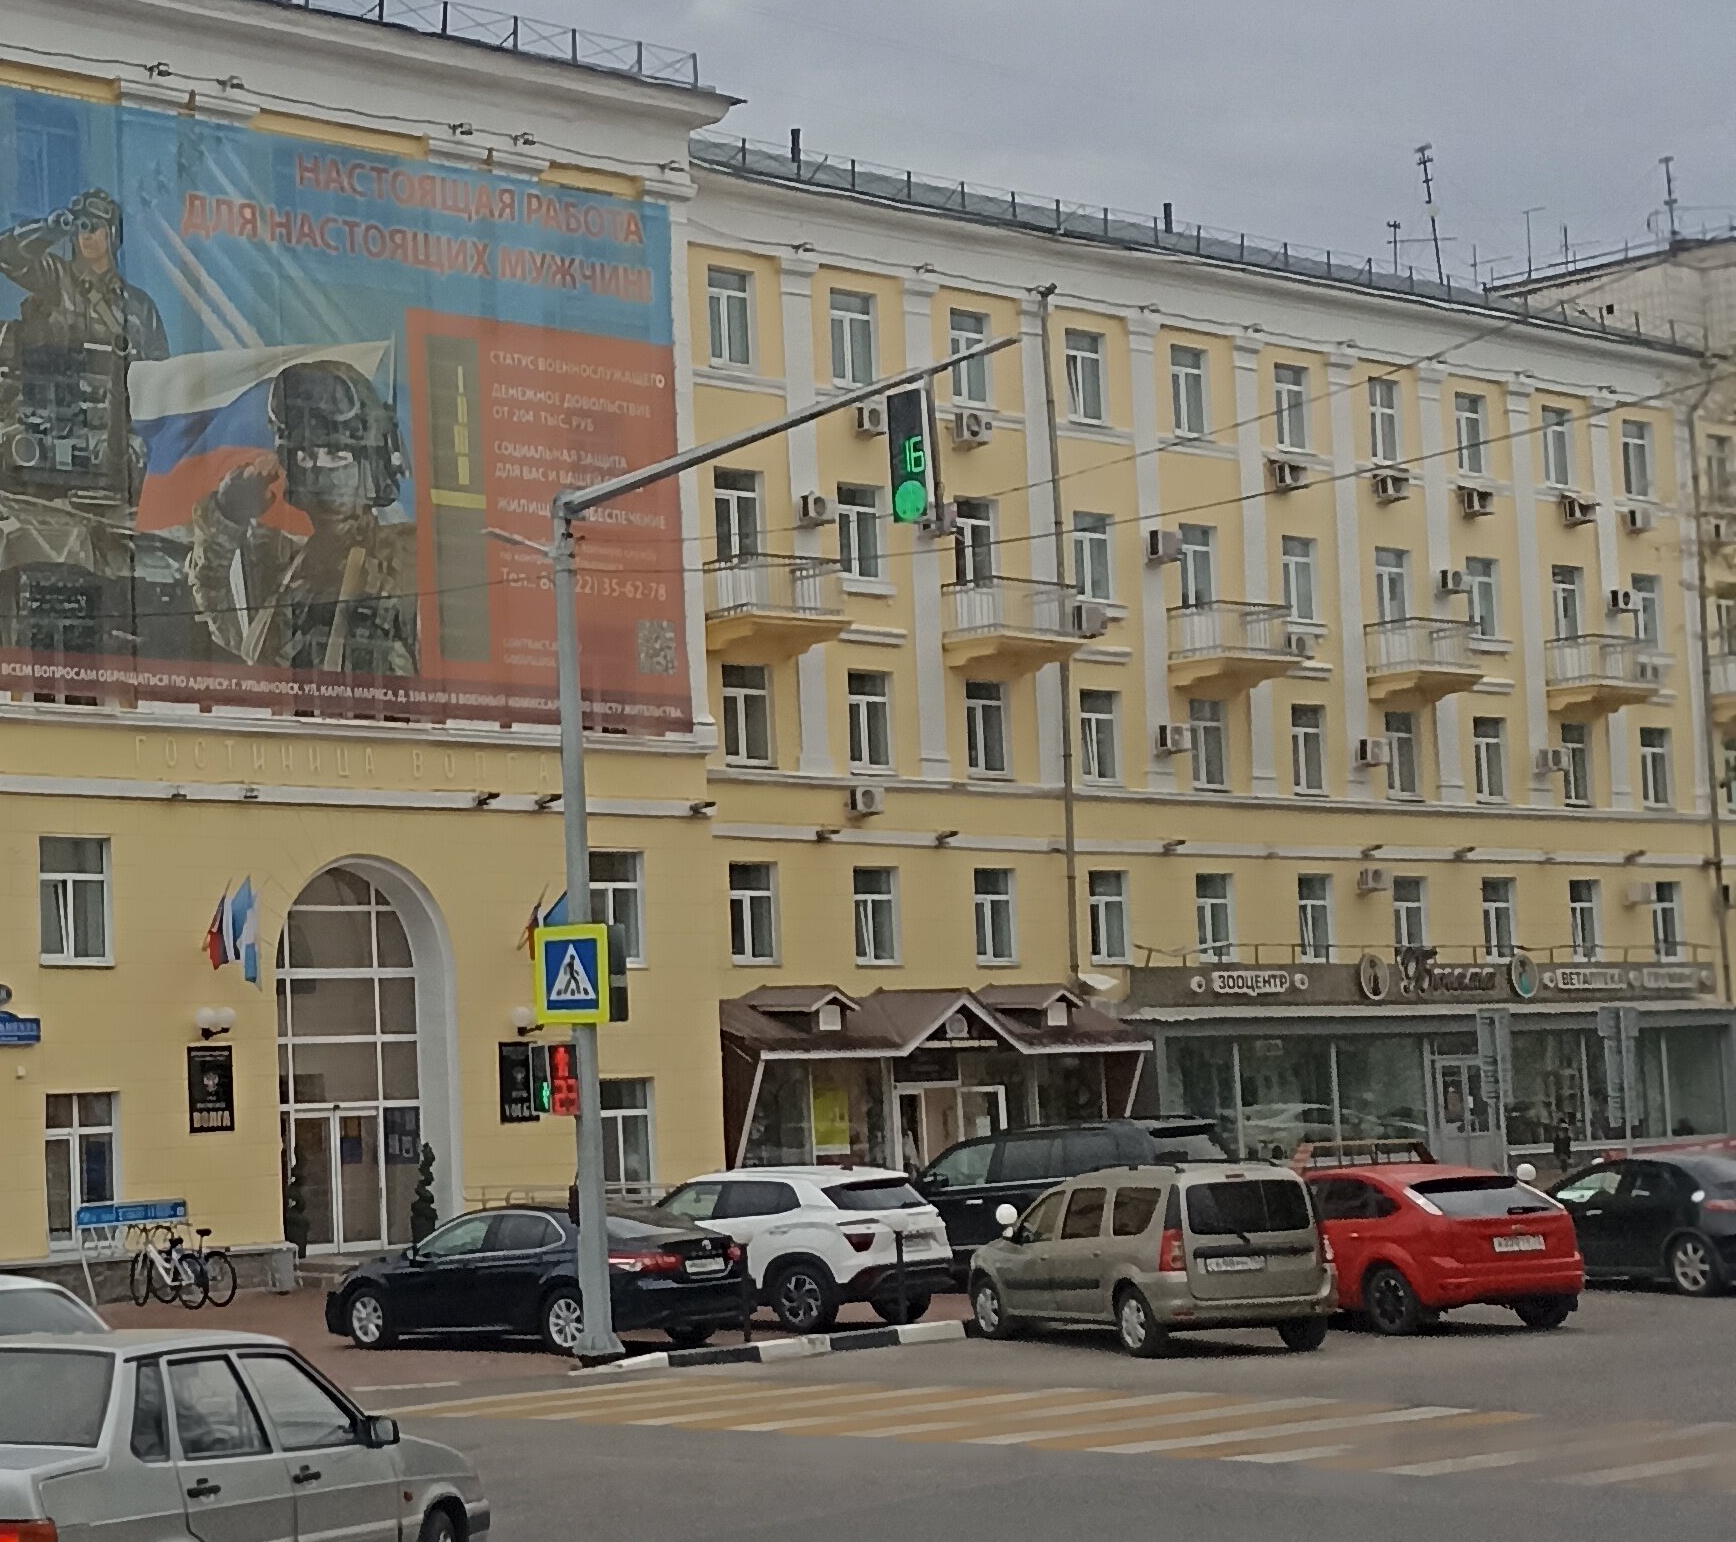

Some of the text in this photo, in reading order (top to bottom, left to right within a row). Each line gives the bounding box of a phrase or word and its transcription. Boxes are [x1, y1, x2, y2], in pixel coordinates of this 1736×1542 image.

[295, 153, 645, 246] НАСТОЯЩАЯ РАБОТА
[181, 192, 653, 304] ДЛЯ НАСТОЯЩИХ МУЖЧИН!
[489, 350, 665, 389] СТАТУС ВОЕННОСЛУЖАЩЕГО
[491, 382, 651, 418] ДЕНЕЖНОЕ ДОВОЛЬСТВИЕ
[492, 406, 509, 420] ОТ
[513, 408, 534, 423] 204
[494, 440, 627, 470] СОЦИАЛЬНАЯ ЗАЩИТА
[904, 435, 925, 473] 16
[495, 462, 521, 478] ДЛЯ
[523, 465, 545, 482] ВАС
[548, 469, 557, 482] И
[497, 498, 552, 517] ЖИЛИЩ
[602, 578, 667, 601] 35-62-78
[2, 663, 32, 677] ВСЕМ
[34, 665, 97, 680] ВОПРОСАМ
[98, 669, 168, 686] ОБРАЩАТЬСЯ
[170, 675, 186, 688] ПО
[134, 736, 551, 782] ГОСТИНИЦА ВОЛГА
[1217, 972, 1288, 994] ЗООЦЕНТР
